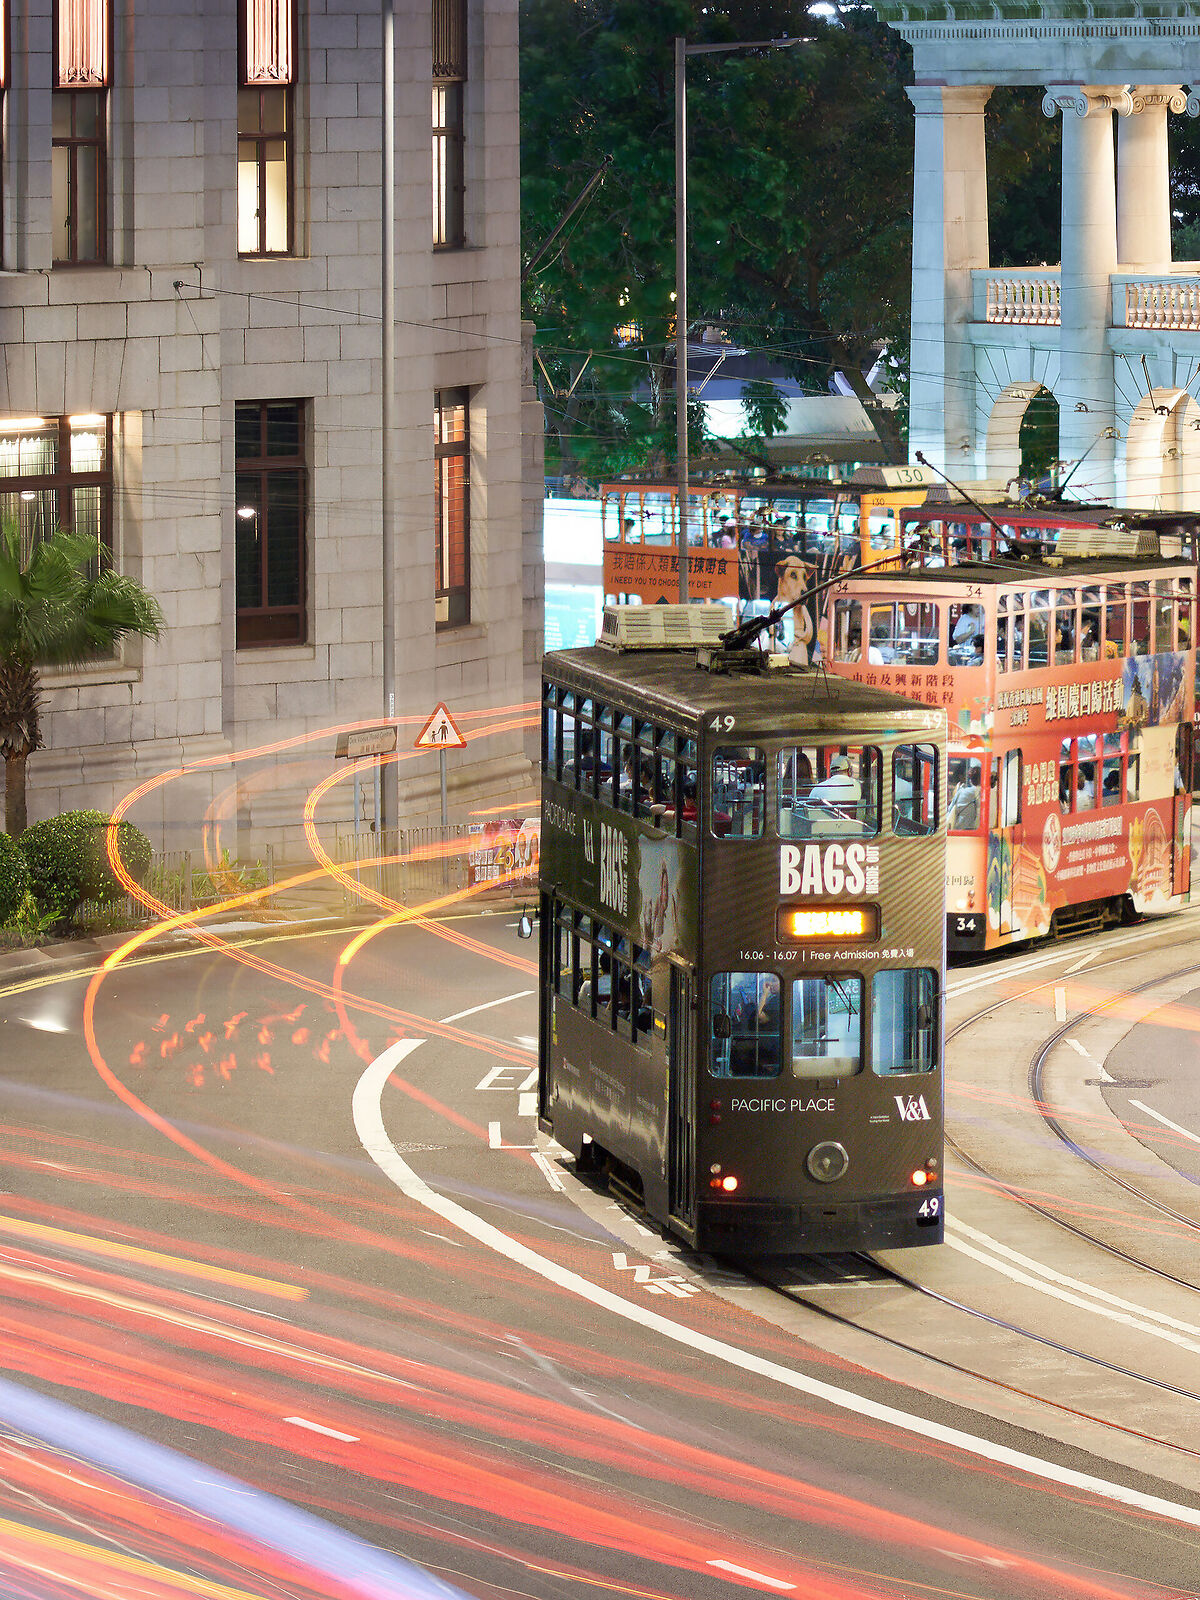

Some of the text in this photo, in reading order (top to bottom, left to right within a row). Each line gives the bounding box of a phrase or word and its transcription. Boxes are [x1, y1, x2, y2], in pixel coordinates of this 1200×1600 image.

[896, 469, 923, 483] 130
[614, 576, 633, 584] NEED
[635, 577, 648, 585] YOU
[649, 577, 657, 586] TO
[658, 578, 681, 587] CHOOS
[697, 581, 713, 589] DIET
[836, 581, 849, 593] 34
[966, 585, 982, 597] 34
[709, 715, 736, 733] 49
[600, 822, 624, 914] BAGS
[779, 843, 866, 895] BAGS
[866, 845, 880, 894] INSIDE OUT
[956, 917, 976, 931] 34
[739, 950, 764, 960] 16.06
[773, 950, 798, 960] 16.07
[810, 950, 832, 960] Free
[834, 950, 880, 960] Admission
[881, 948, 914, 959] 免費入場
[731, 1098, 835, 1112] PACIFIC PLACE
[894, 1094, 932, 1122] V&A
[918, 1197, 939, 1217] 49
